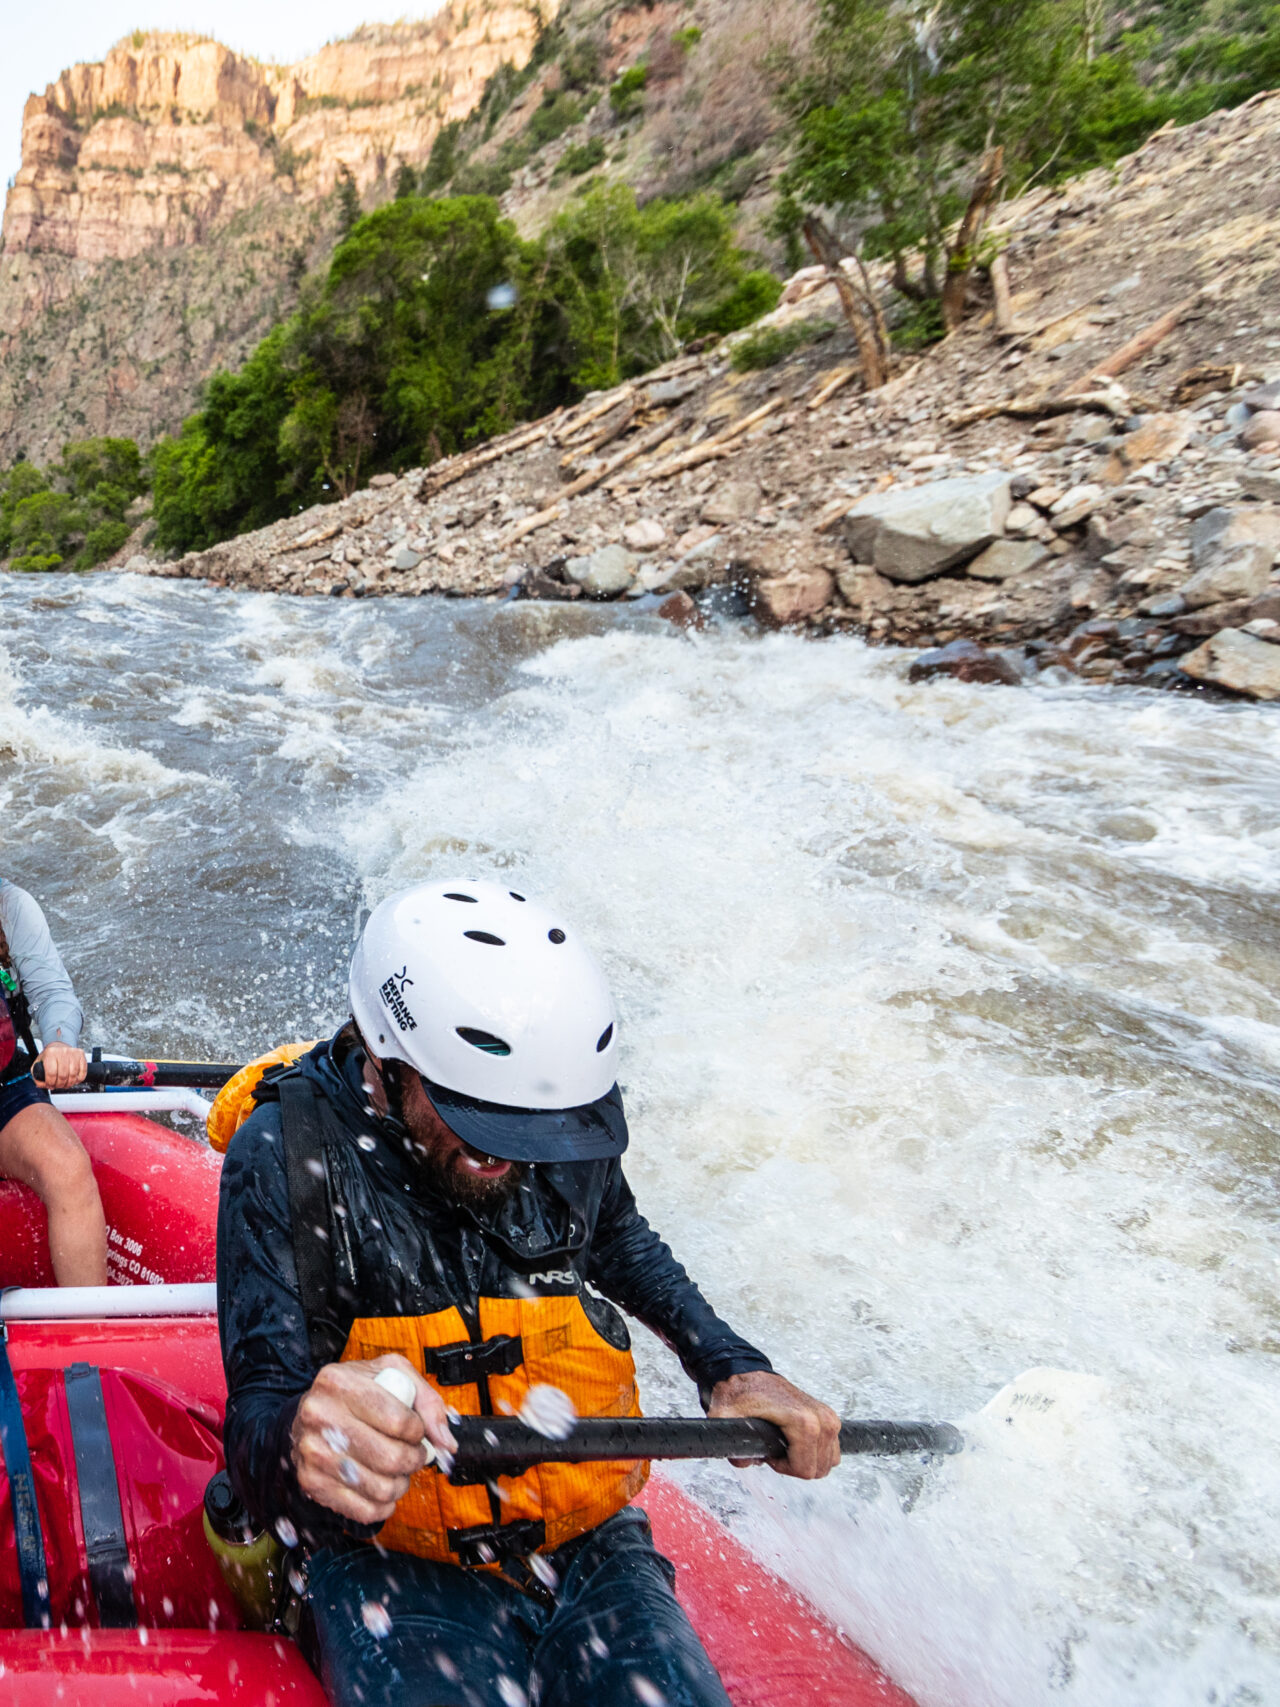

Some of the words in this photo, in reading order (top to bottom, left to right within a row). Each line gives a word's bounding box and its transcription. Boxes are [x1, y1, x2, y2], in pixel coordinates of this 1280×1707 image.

[381, 982, 408, 1031] RAFTING
[387, 976, 418, 1031] DEFIANCE
[109, 1228, 124, 1246] Box
[123, 1237, 144, 1257] 3006
[106, 1248, 129, 1268] prings
[128, 1259, 141, 1275] CO
[529, 1270, 575, 1285] NRS
